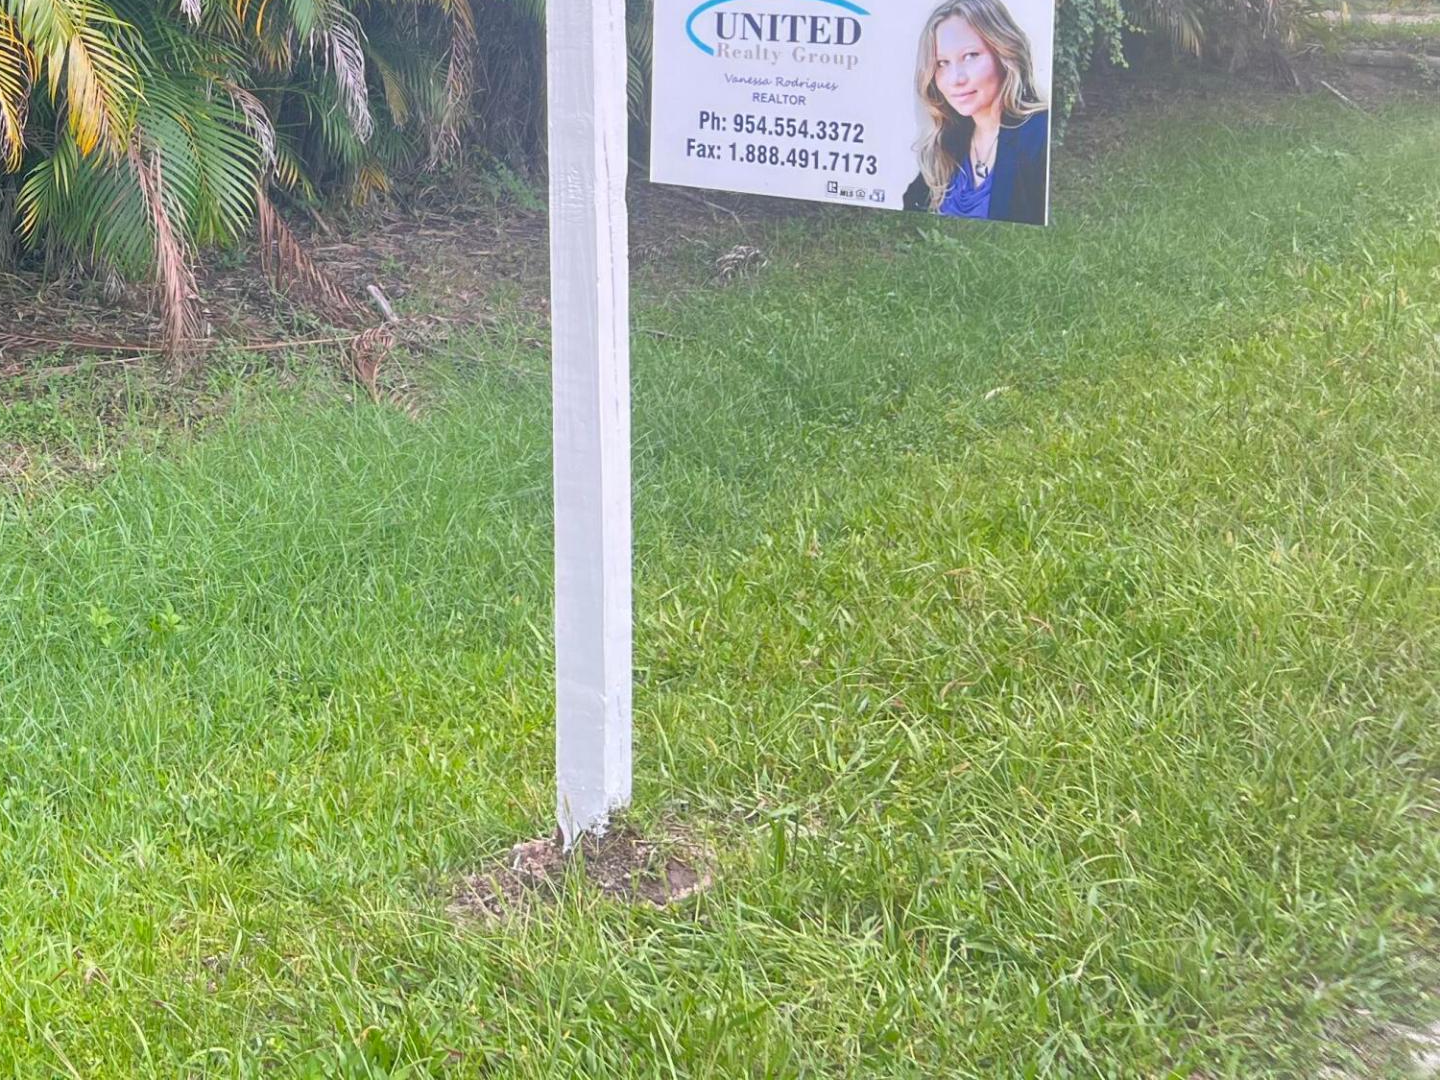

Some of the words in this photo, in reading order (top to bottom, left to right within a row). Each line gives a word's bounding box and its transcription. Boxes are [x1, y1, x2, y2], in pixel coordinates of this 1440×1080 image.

[714, 11, 862, 46] UNITED
[716, 42, 782, 66] Realty
[792, 46, 859, 70] Group
[724, 73, 773, 86] Vanessa
[775, 76, 839, 91] Rodrigues
[752, 92, 807, 106] REALTOR
[699, 111, 727, 131] Ph:
[733, 113, 864, 143] 954.554.3372
[686, 138, 721, 160] Fax:
[728, 141, 878, 175] 1.888.491.7173
